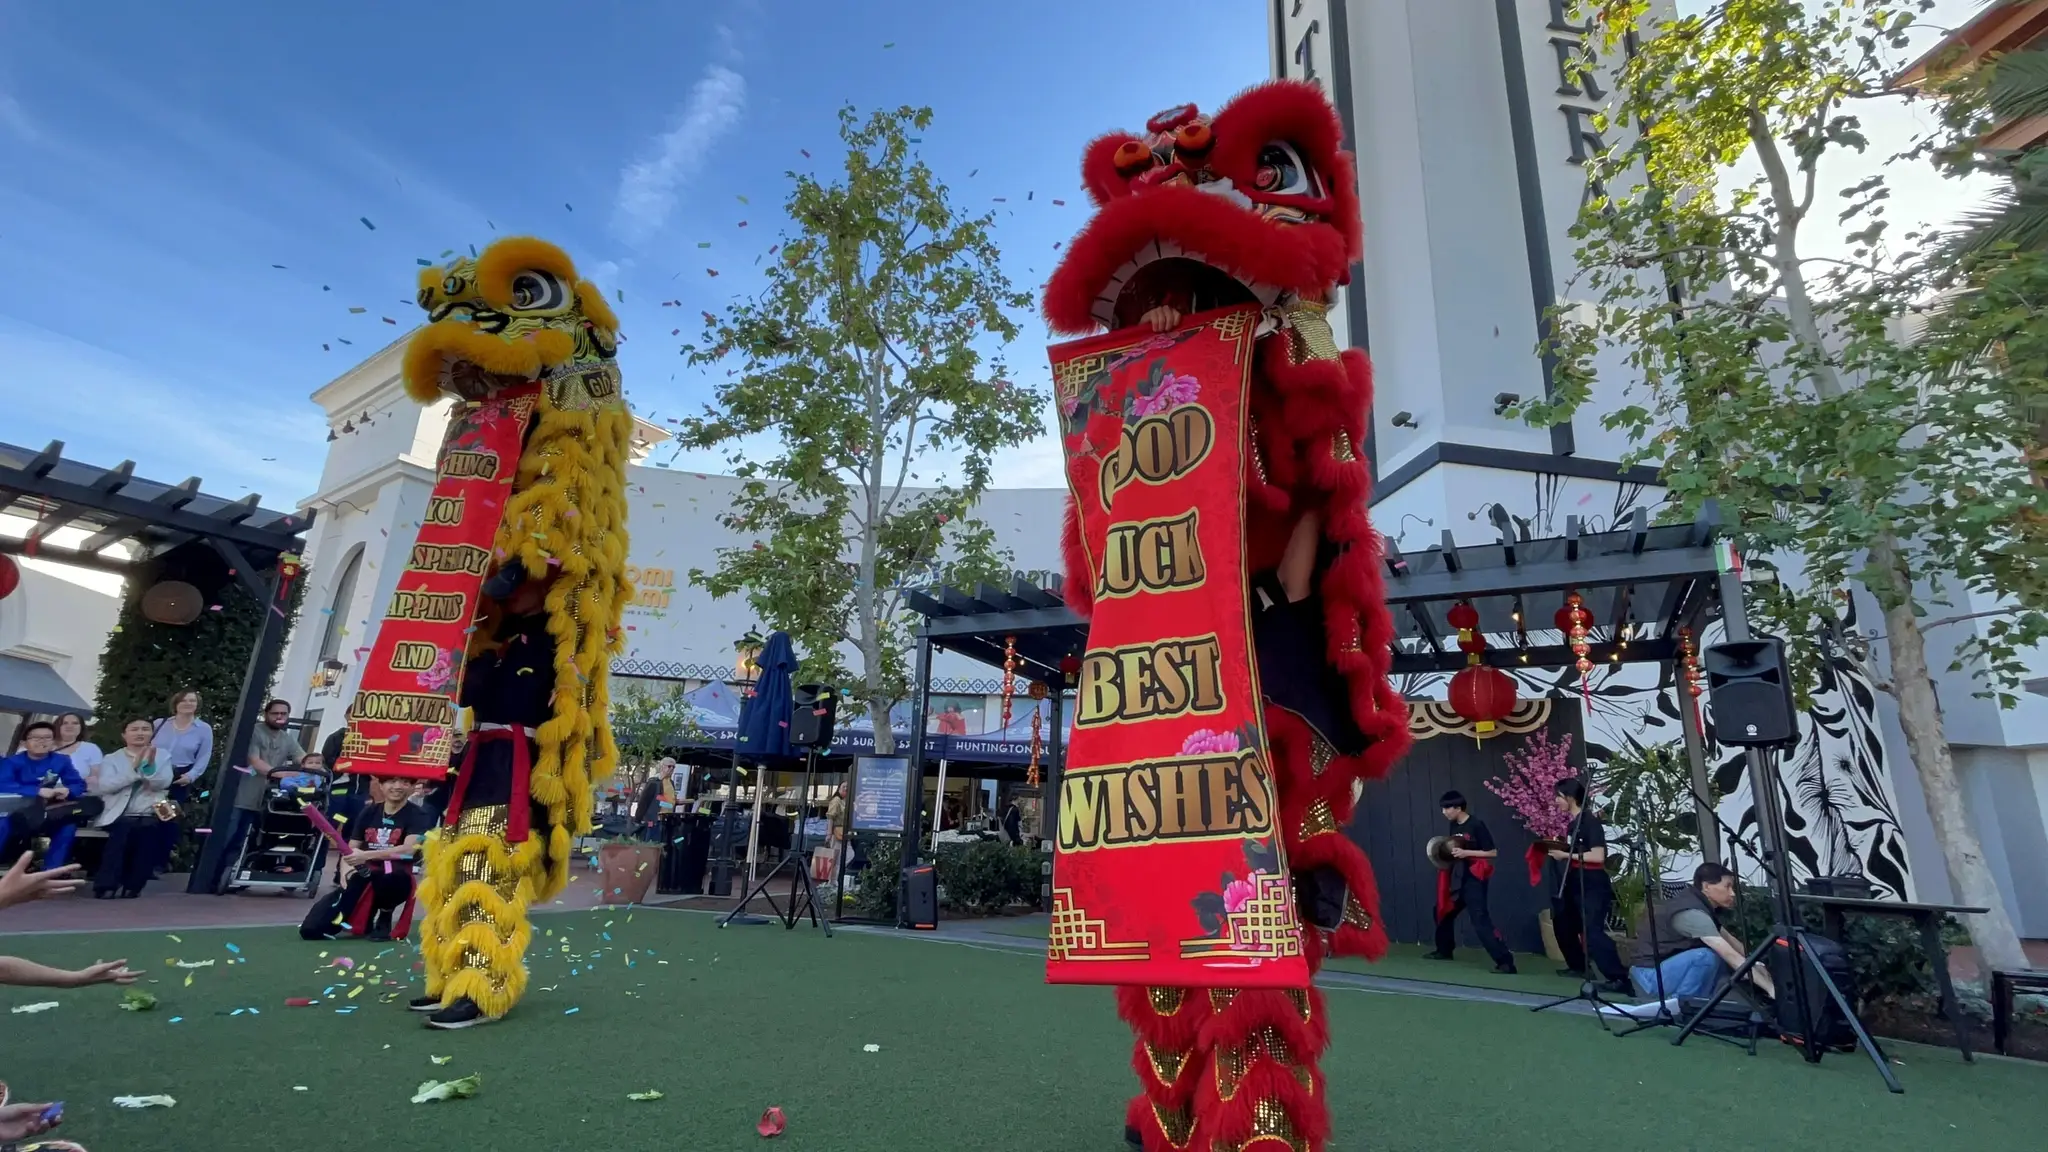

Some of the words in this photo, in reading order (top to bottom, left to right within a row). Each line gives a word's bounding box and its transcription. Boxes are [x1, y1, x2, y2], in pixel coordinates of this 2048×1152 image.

[423, 497, 465, 526] YOU
[1097, 510, 1205, 597] UCK
[390, 641, 437, 671] AND
[1077, 634, 1224, 729] BEST
[956, 741, 1033, 754] HUNTINGTON
[1059, 748, 1272, 852] WISHES
